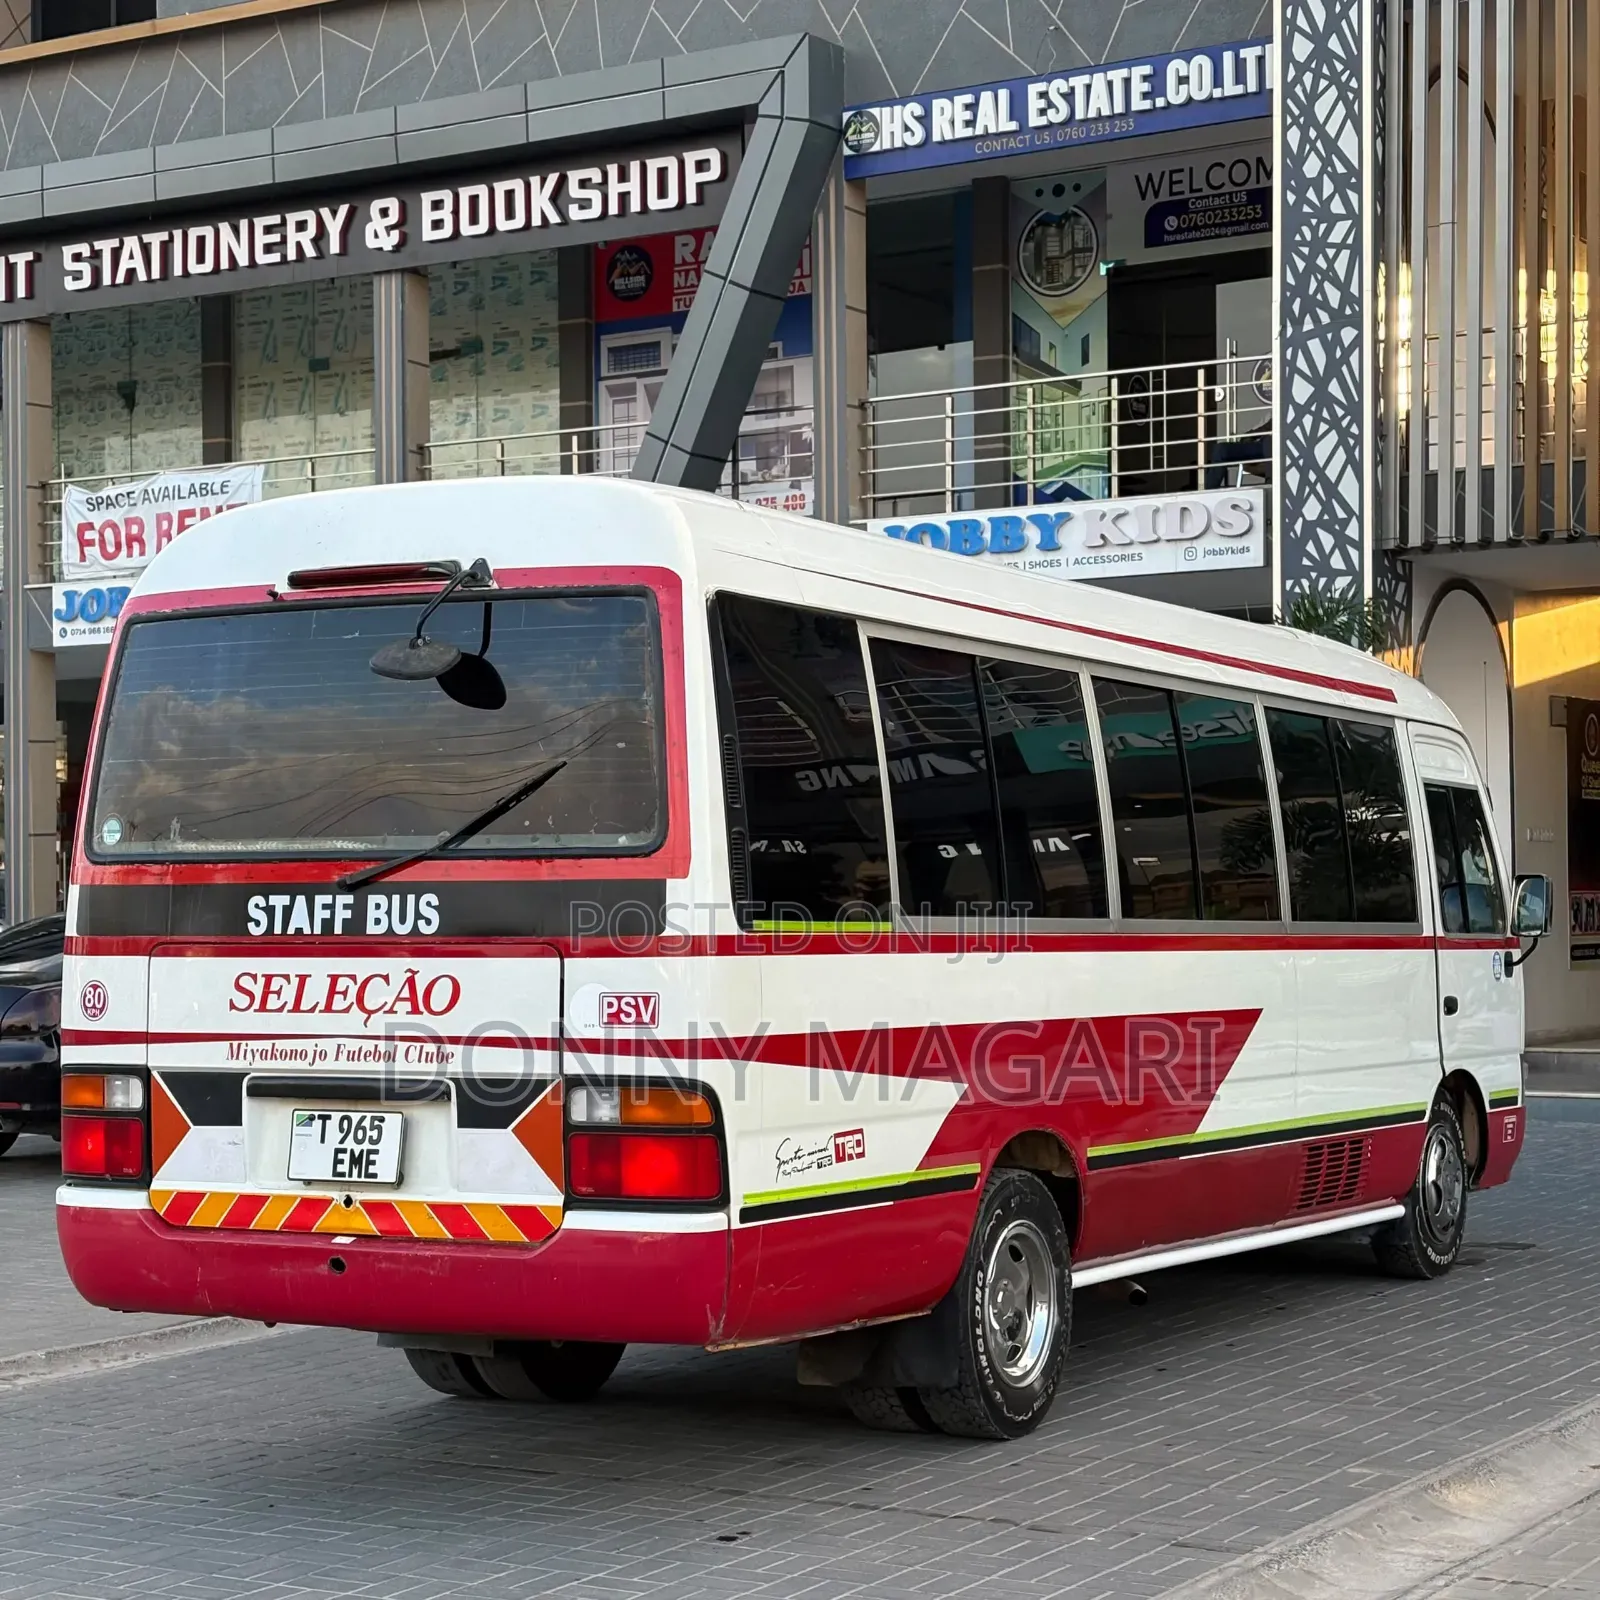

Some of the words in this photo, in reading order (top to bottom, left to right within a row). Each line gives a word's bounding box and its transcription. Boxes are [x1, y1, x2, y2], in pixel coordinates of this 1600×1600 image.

[881, 103, 925, 149] HS
[932, 87, 1019, 142] REAL
[975, 134, 1031, 154] CONTACT
[1057, 127, 1086, 142] 0760
[1090, 122, 1111, 136] 233
[1114, 118, 1134, 133] 253
[1179, 204, 1263, 228] 0760233253
[1188, 194, 1230, 209] Contact
[1232, 191, 1247, 202] US
[0, 251, 38, 301] T
[62, 203, 354, 292] STATIONERY
[365, 197, 402, 251] &
[420, 147, 725, 242] BOOKSHOP
[1163, 221, 1269, 243] hsrestate2024@gmail.com
[85, 491, 138, 512] SPACE
[141, 480, 231, 505] AVAILABLE
[1084, 497, 1254, 548] KIDS
[76, 516, 146, 563] FOR
[1028, 559, 1062, 570] SHOES
[1073, 552, 1144, 566] ACCESSORIES
[247, 895, 354, 936] STAFF
[366, 893, 440, 935] BUS
[85, 987, 104, 1008] 80
[87, 1008, 100, 1017] KPH
[229, 967, 461, 1028] SELEÇÃO
[602, 996, 656, 1024] PSV
[333, 1043, 397, 1064] Futebol
[404, 1043, 455, 1065] Clube
[317, 1114, 332, 1144] T
[338, 1114, 386, 1146] 965
[332, 1147, 380, 1179] EME
